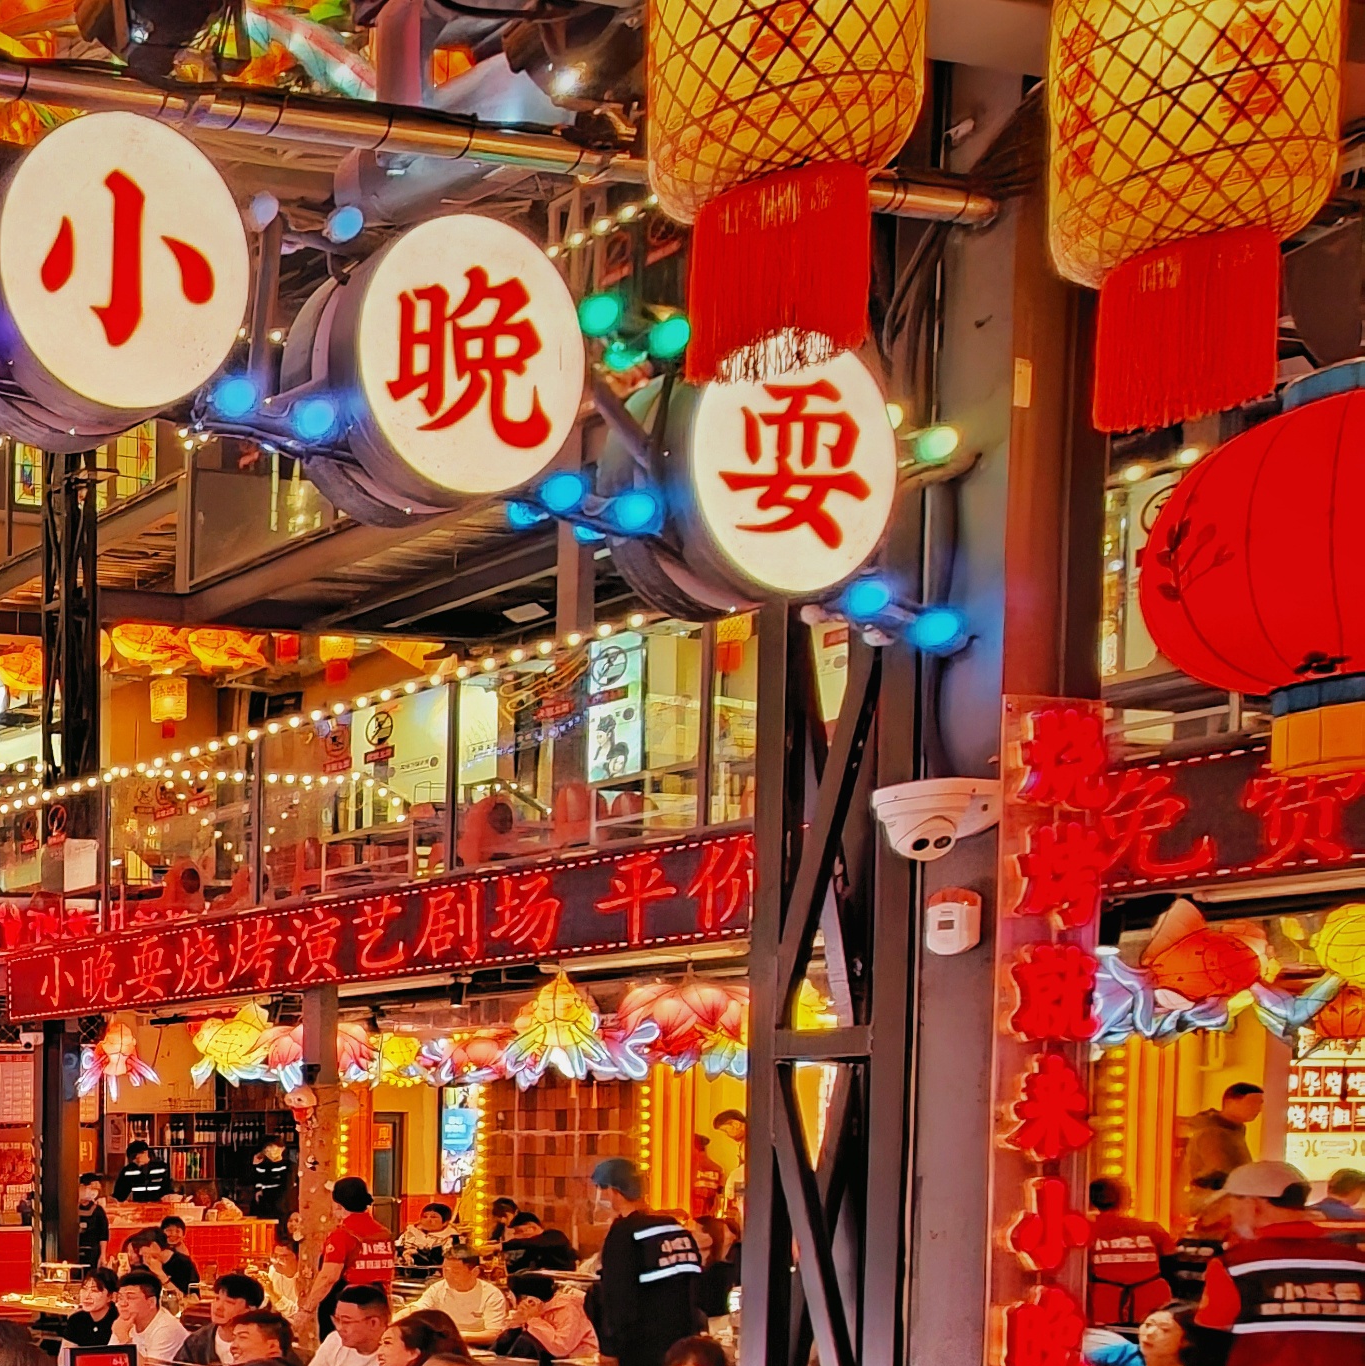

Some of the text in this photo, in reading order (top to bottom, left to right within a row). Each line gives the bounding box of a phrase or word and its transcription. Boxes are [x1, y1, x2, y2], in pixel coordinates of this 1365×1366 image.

[40, 170, 216, 348] 小
[387, 266, 553, 449] 晚
[721, 379, 871, 549] 耍
[39, 869, 563, 1008] 小晚耍烧烤演艺剧场
[595, 838, 753, 944] 平价
